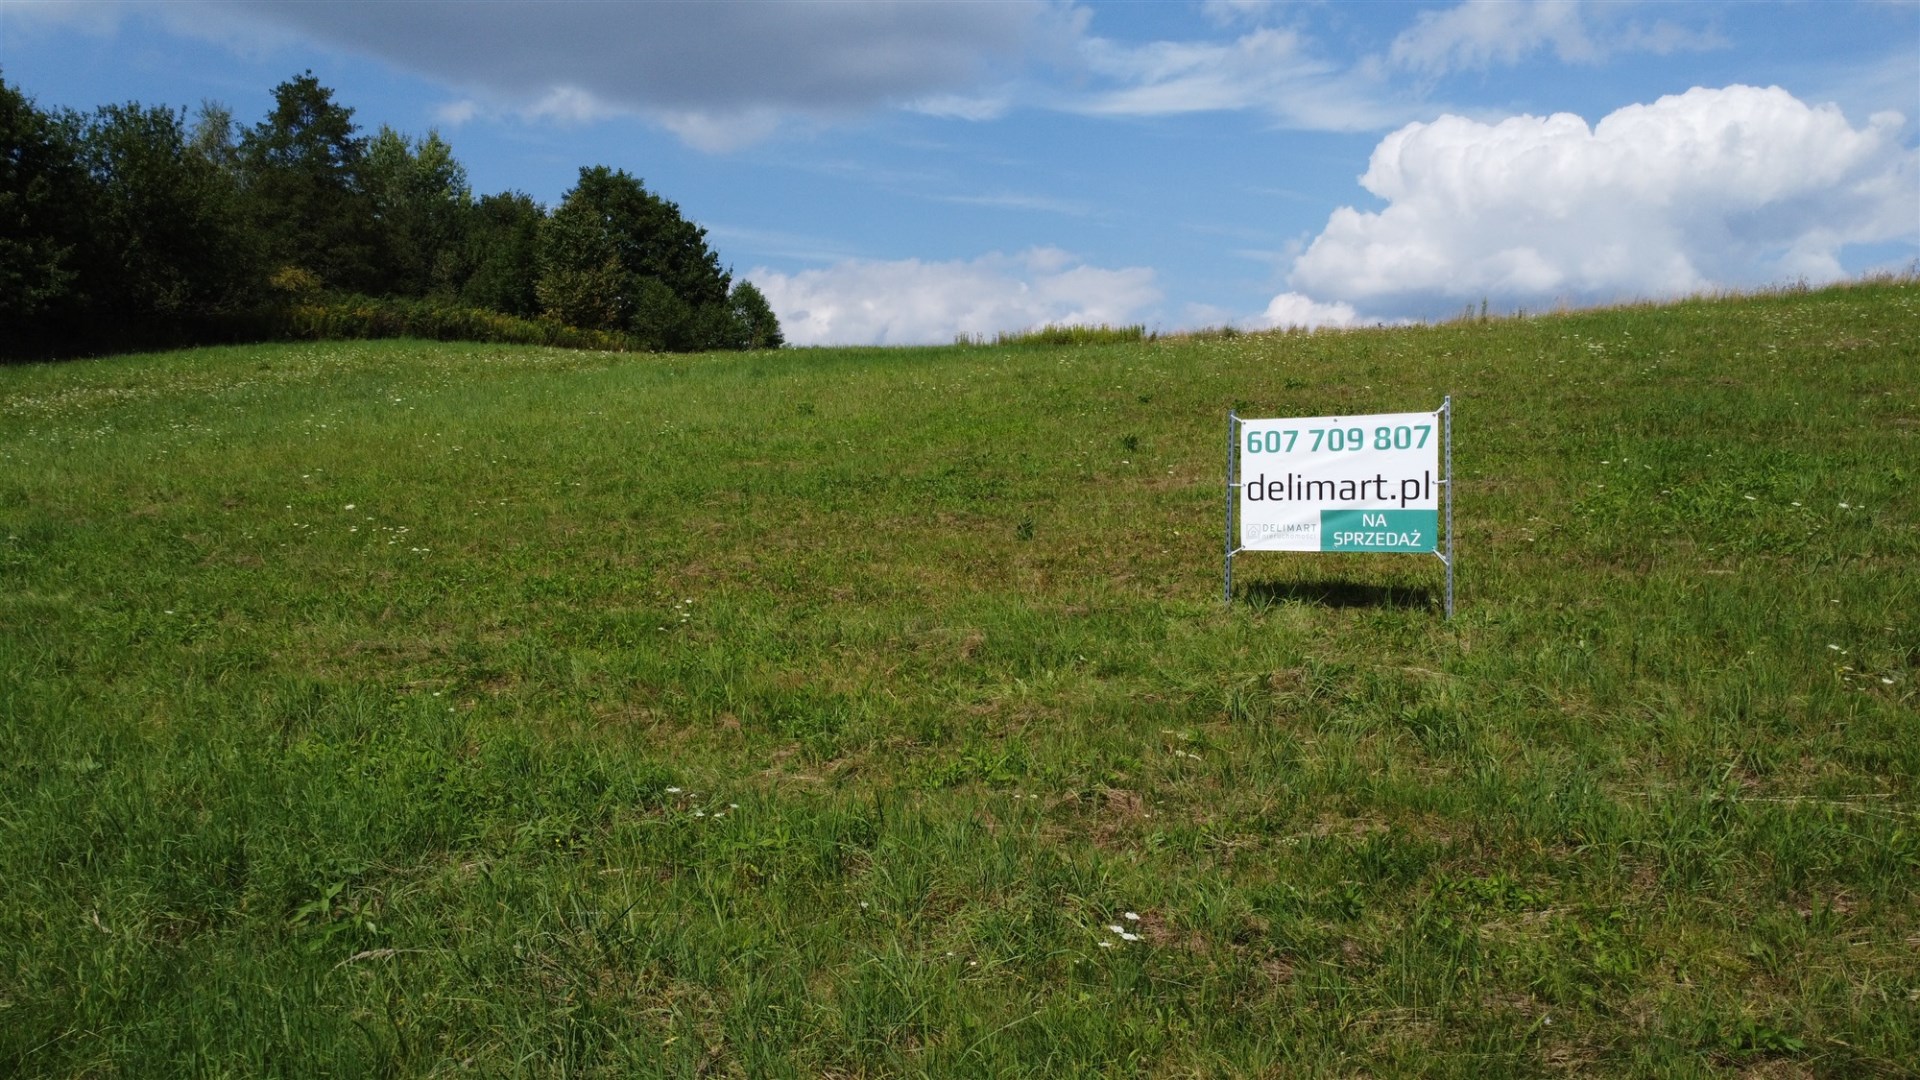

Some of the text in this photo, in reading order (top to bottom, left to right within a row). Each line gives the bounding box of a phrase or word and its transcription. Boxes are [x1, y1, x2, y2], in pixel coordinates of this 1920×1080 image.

[1247, 425, 1431, 454] 607 709 807
[1247, 470, 1430, 508] delimart.pl
[1262, 523, 1317, 532] DELIMART
[1362, 514, 1387, 527] NA
[1333, 529, 1422, 547] SPRZEDAŻ
